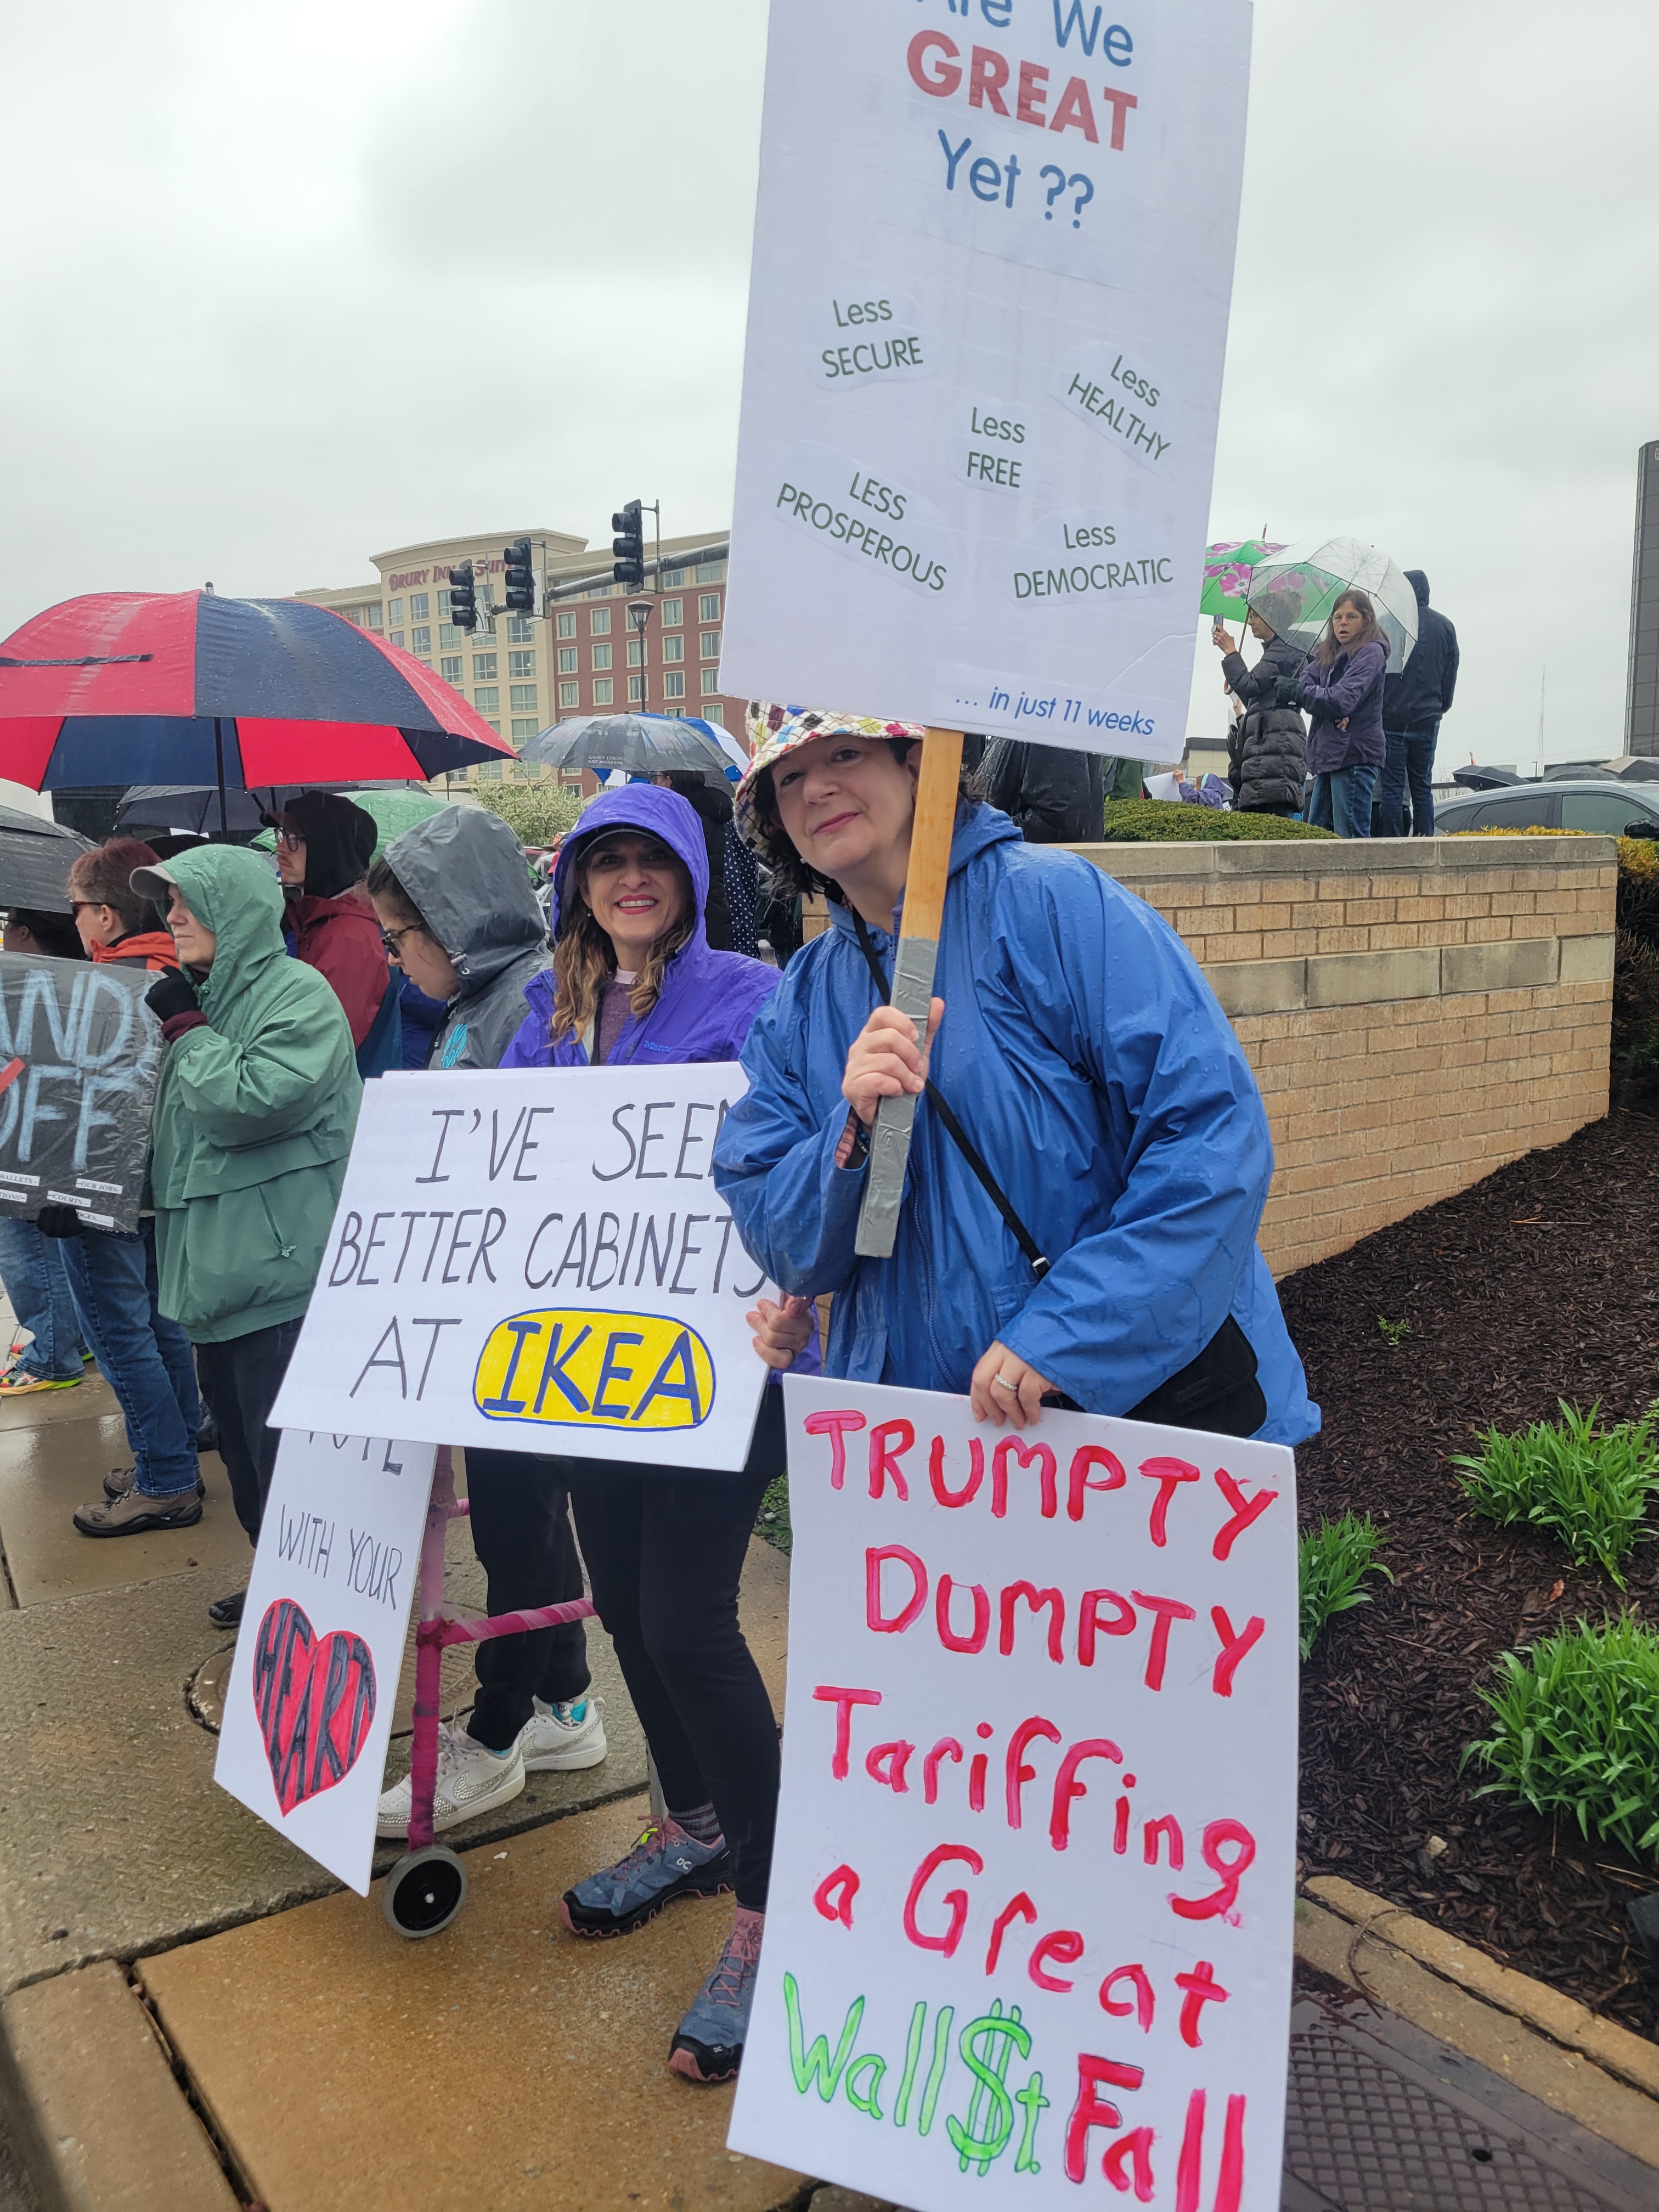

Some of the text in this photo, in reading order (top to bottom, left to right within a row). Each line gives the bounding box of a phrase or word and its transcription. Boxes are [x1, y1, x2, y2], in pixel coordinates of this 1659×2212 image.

[1053, 0, 1133, 66] We
[906, 29, 1138, 151] GREAT
[938, 129, 1094, 229] Yet ??
[832, 298, 893, 328] Less
[821, 337, 924, 378] SECURE
[1110, 354, 1161, 408] Less
[970, 407, 1025, 443] Less
[1068, 373, 1172, 461] HEALTHY
[849, 471, 907, 521] LESS
[967, 451, 1023, 488] FREE
[776, 483, 947, 591] PROSPEROUS
[1014, 557, 1174, 599] DEMOCRATIC
[1063, 523, 1116, 549] Less
[989, 686, 1009, 711] in
[1014, 691, 1057, 720] just
[1063, 699, 1081, 723] 11
[1088, 708, 1155, 736] weeks
[415, 1107, 555, 1183] I'VE
[328, 1207, 507, 1288] BETTER
[349, 1315, 703, 1426] AT IKEA
[803, 1409, 1279, 1561] TRUMPTY
[278, 1503, 403, 1611] WITH YOUR
[865, 1544, 1265, 1698] DUMPTY
[255, 1600, 377, 1806] HEART
[812, 1685, 1256, 1928] Tariffing
[813, 1843, 1232, 2048] a Great
[1063, 2052, 1246, 2212] Fall
